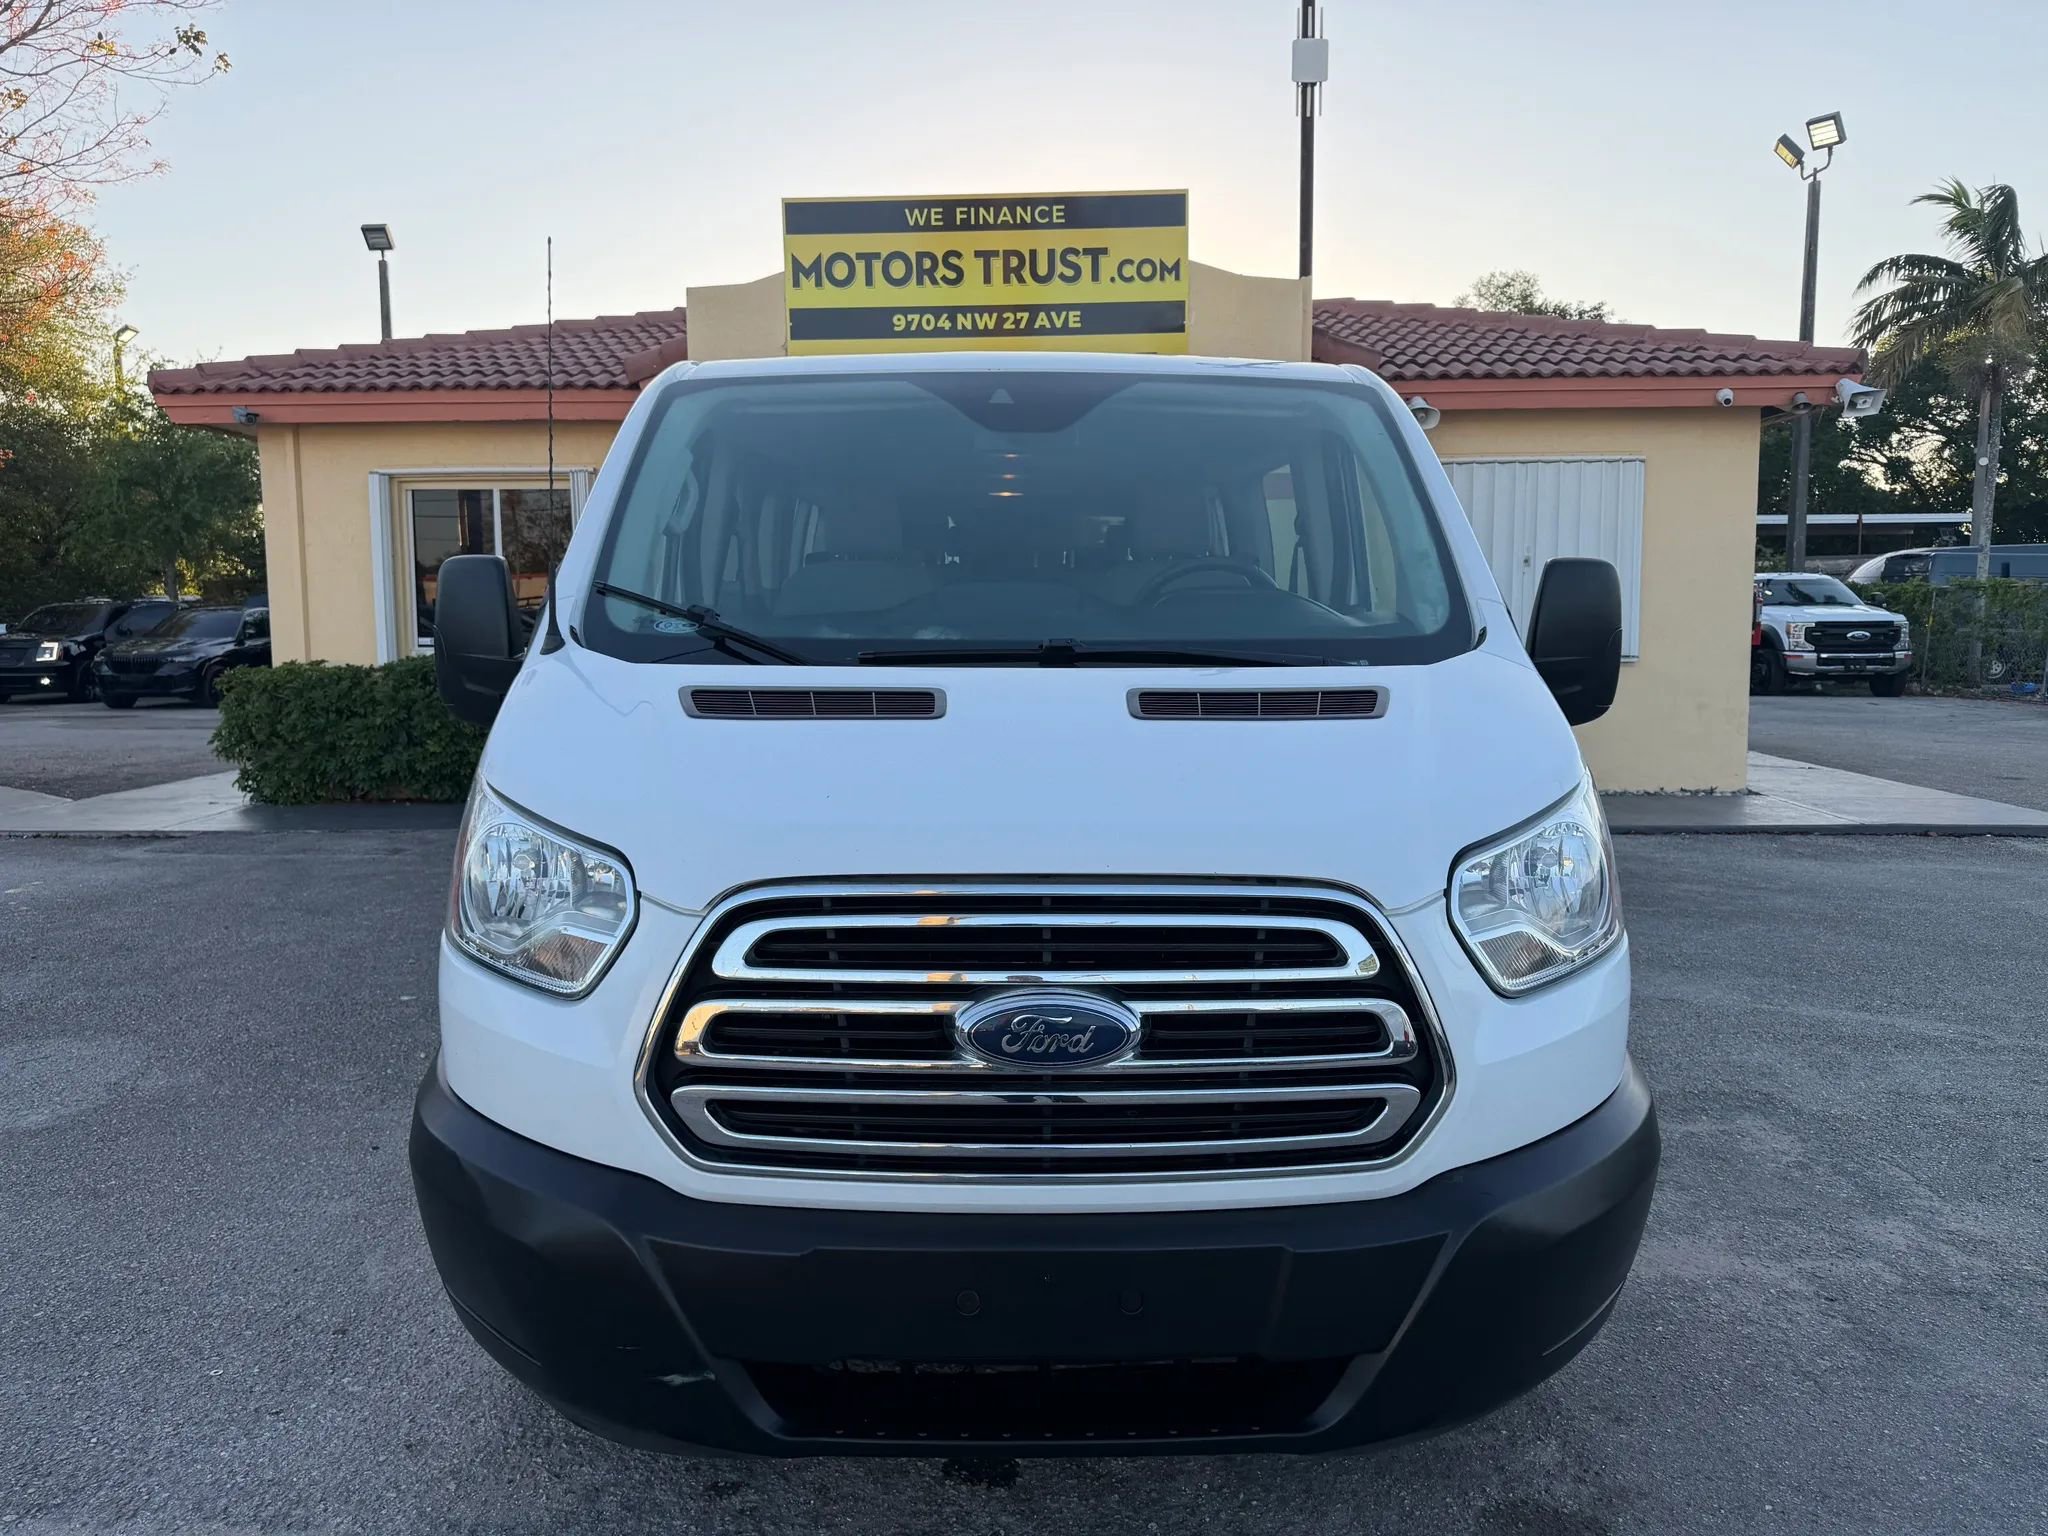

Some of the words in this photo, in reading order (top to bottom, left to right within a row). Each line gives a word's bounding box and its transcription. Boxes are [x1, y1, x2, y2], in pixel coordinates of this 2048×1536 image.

[905, 207, 944, 226] WE
[956, 205, 1066, 225] FINANCE
[791, 251, 965, 289] MOTORS
[892, 313, 952, 332] 9704
[957, 312, 998, 331] NW
[1002, 311, 1030, 330] 27
[1034, 311, 1082, 329] AVE
[1002, 1014, 1096, 1054] Ford
